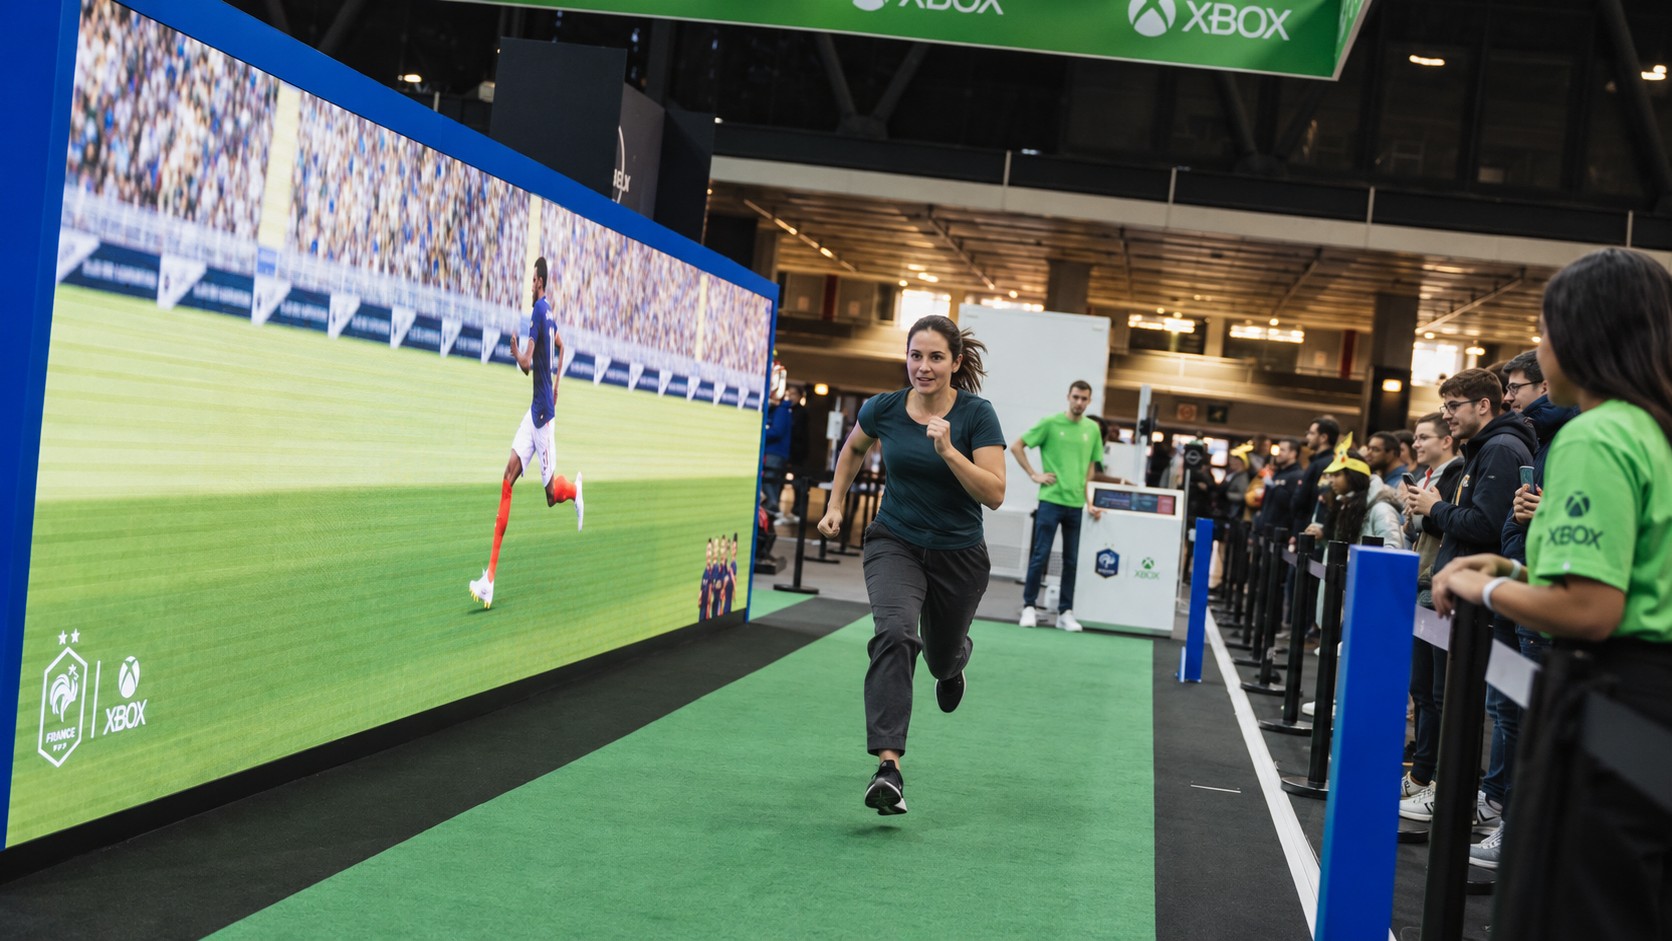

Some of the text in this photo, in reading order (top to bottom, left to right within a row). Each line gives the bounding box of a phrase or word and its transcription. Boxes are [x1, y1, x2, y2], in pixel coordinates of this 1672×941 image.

[1182, 0, 1292, 41] XBOX
[1546, 525, 1604, 550] XBOX
[103, 699, 147, 735] XBOX
